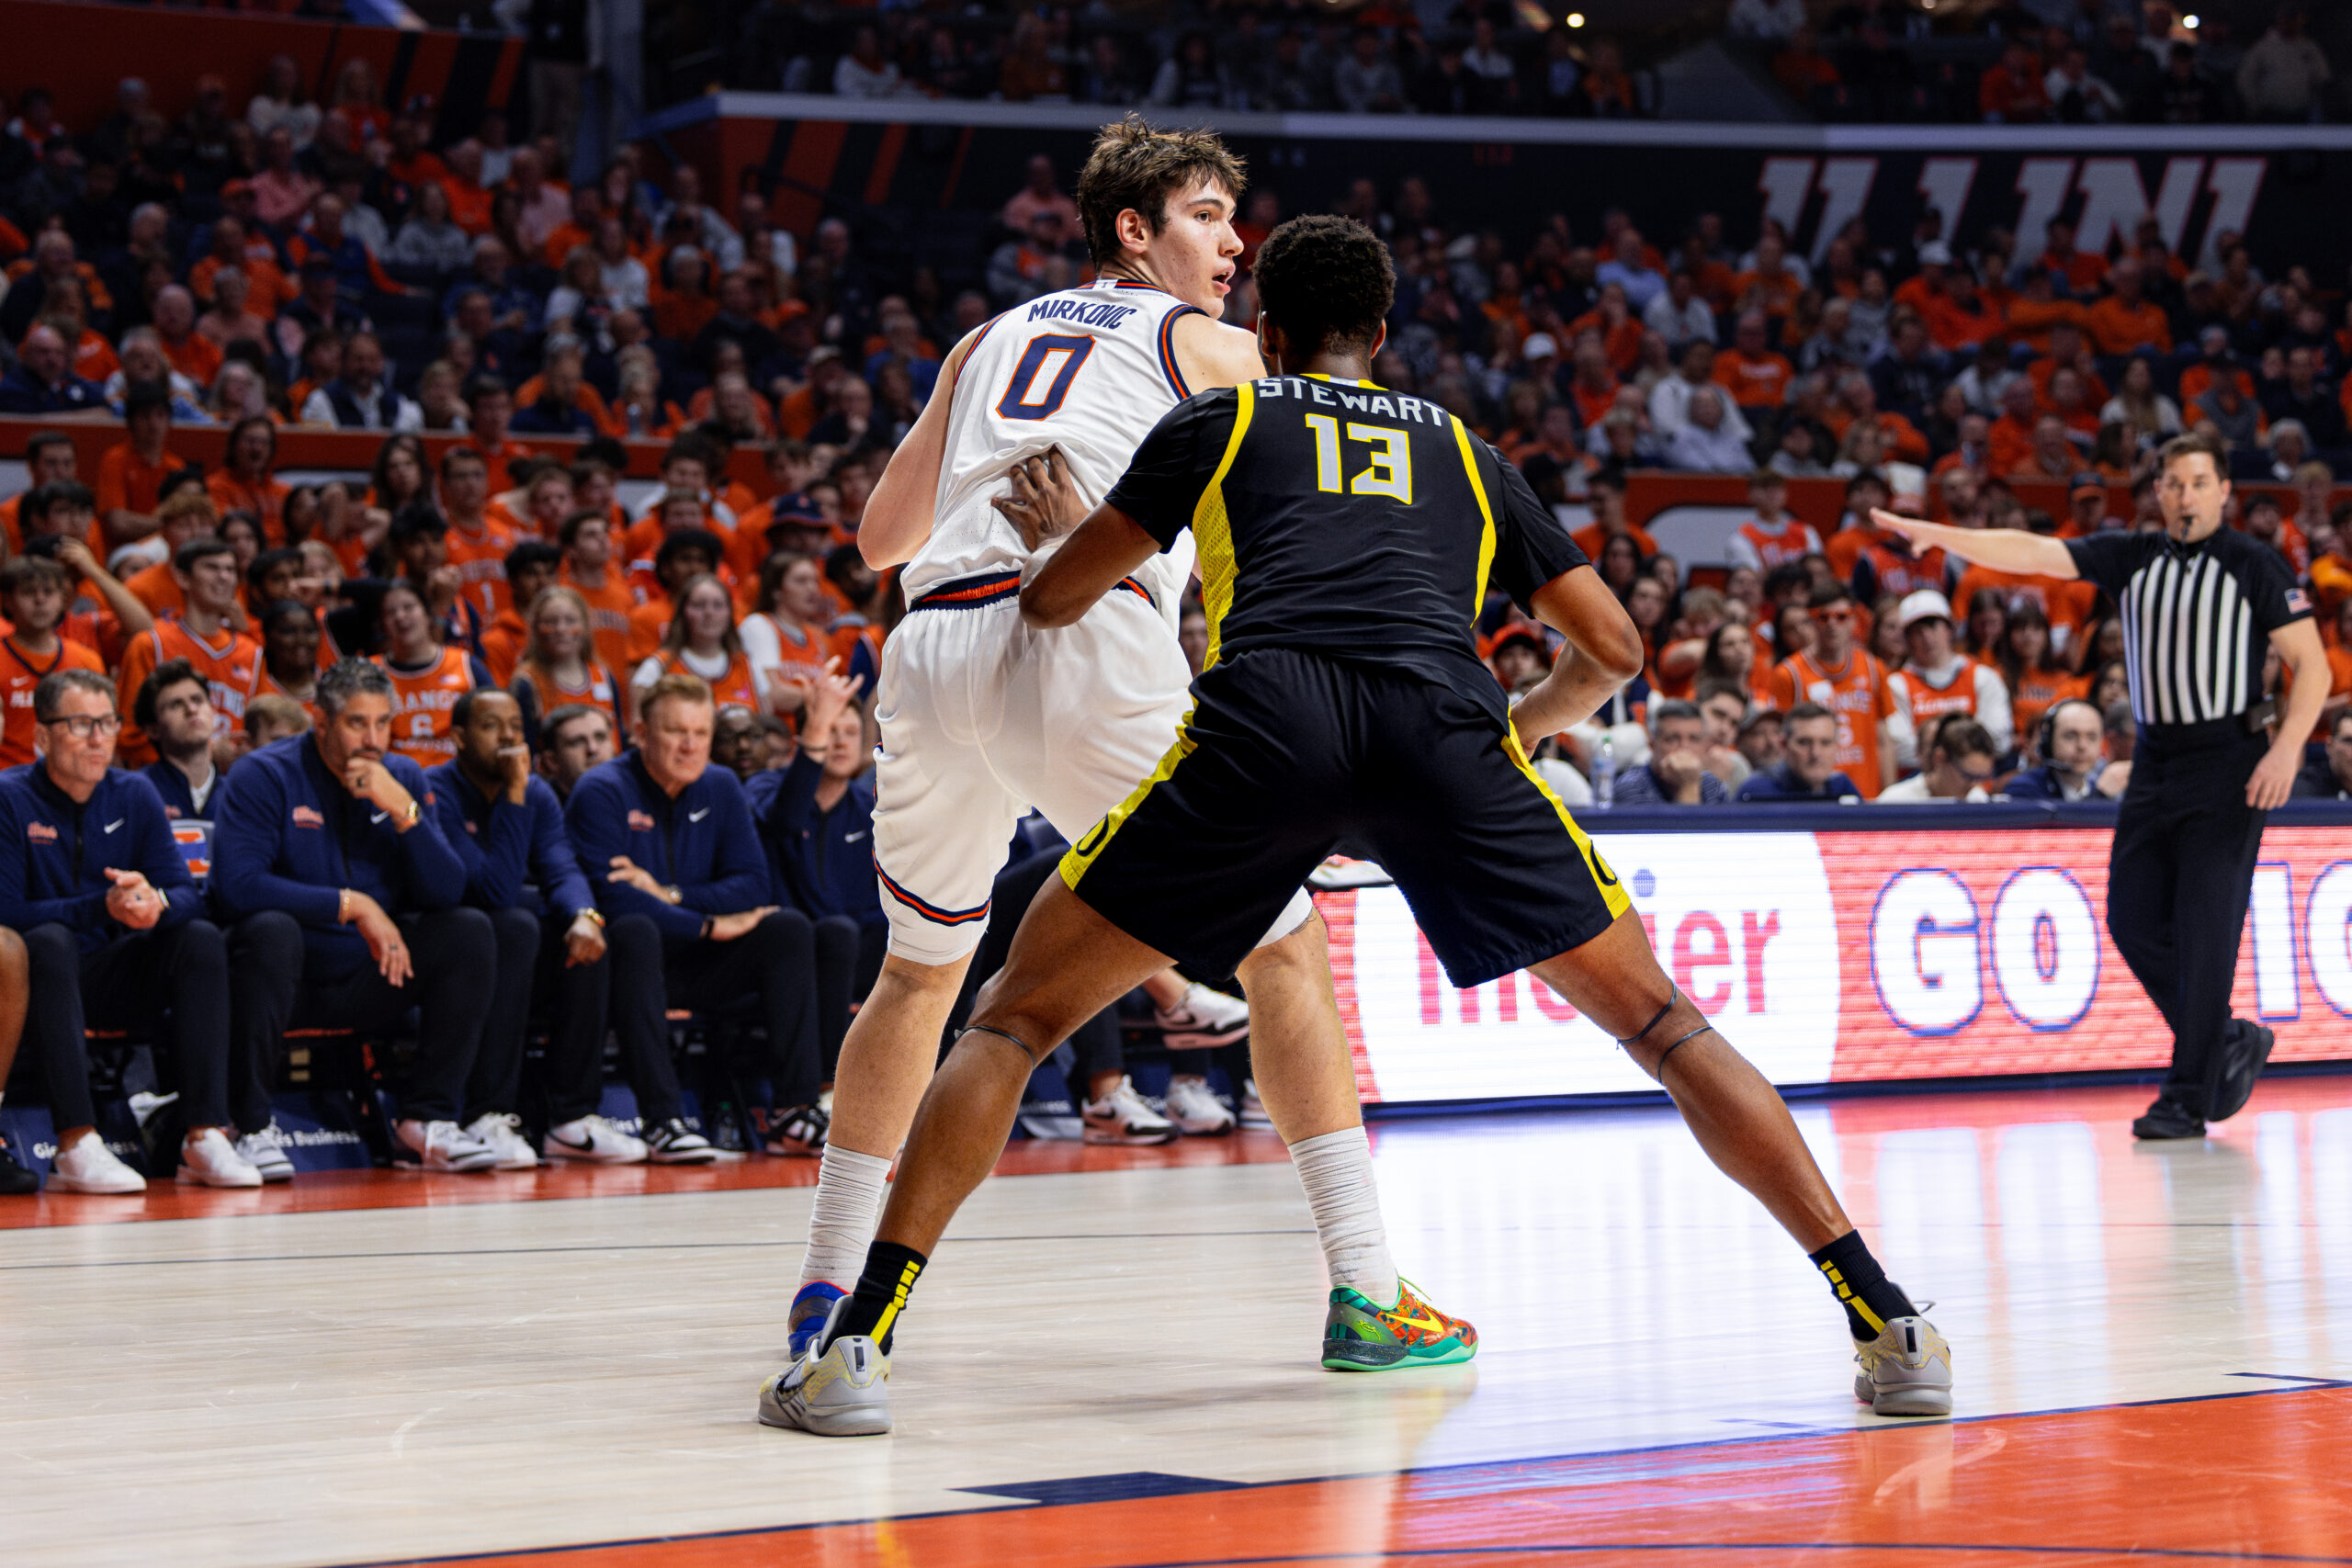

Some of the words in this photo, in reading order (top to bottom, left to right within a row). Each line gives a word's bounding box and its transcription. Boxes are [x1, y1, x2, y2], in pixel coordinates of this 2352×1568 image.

[1027, 299, 1138, 330] MIRKOVIC
[996, 333, 1096, 422] 0
[1257, 378, 1443, 427] STEWART
[1305, 413, 1413, 505] 13
[1869, 865, 2101, 1036] GO
